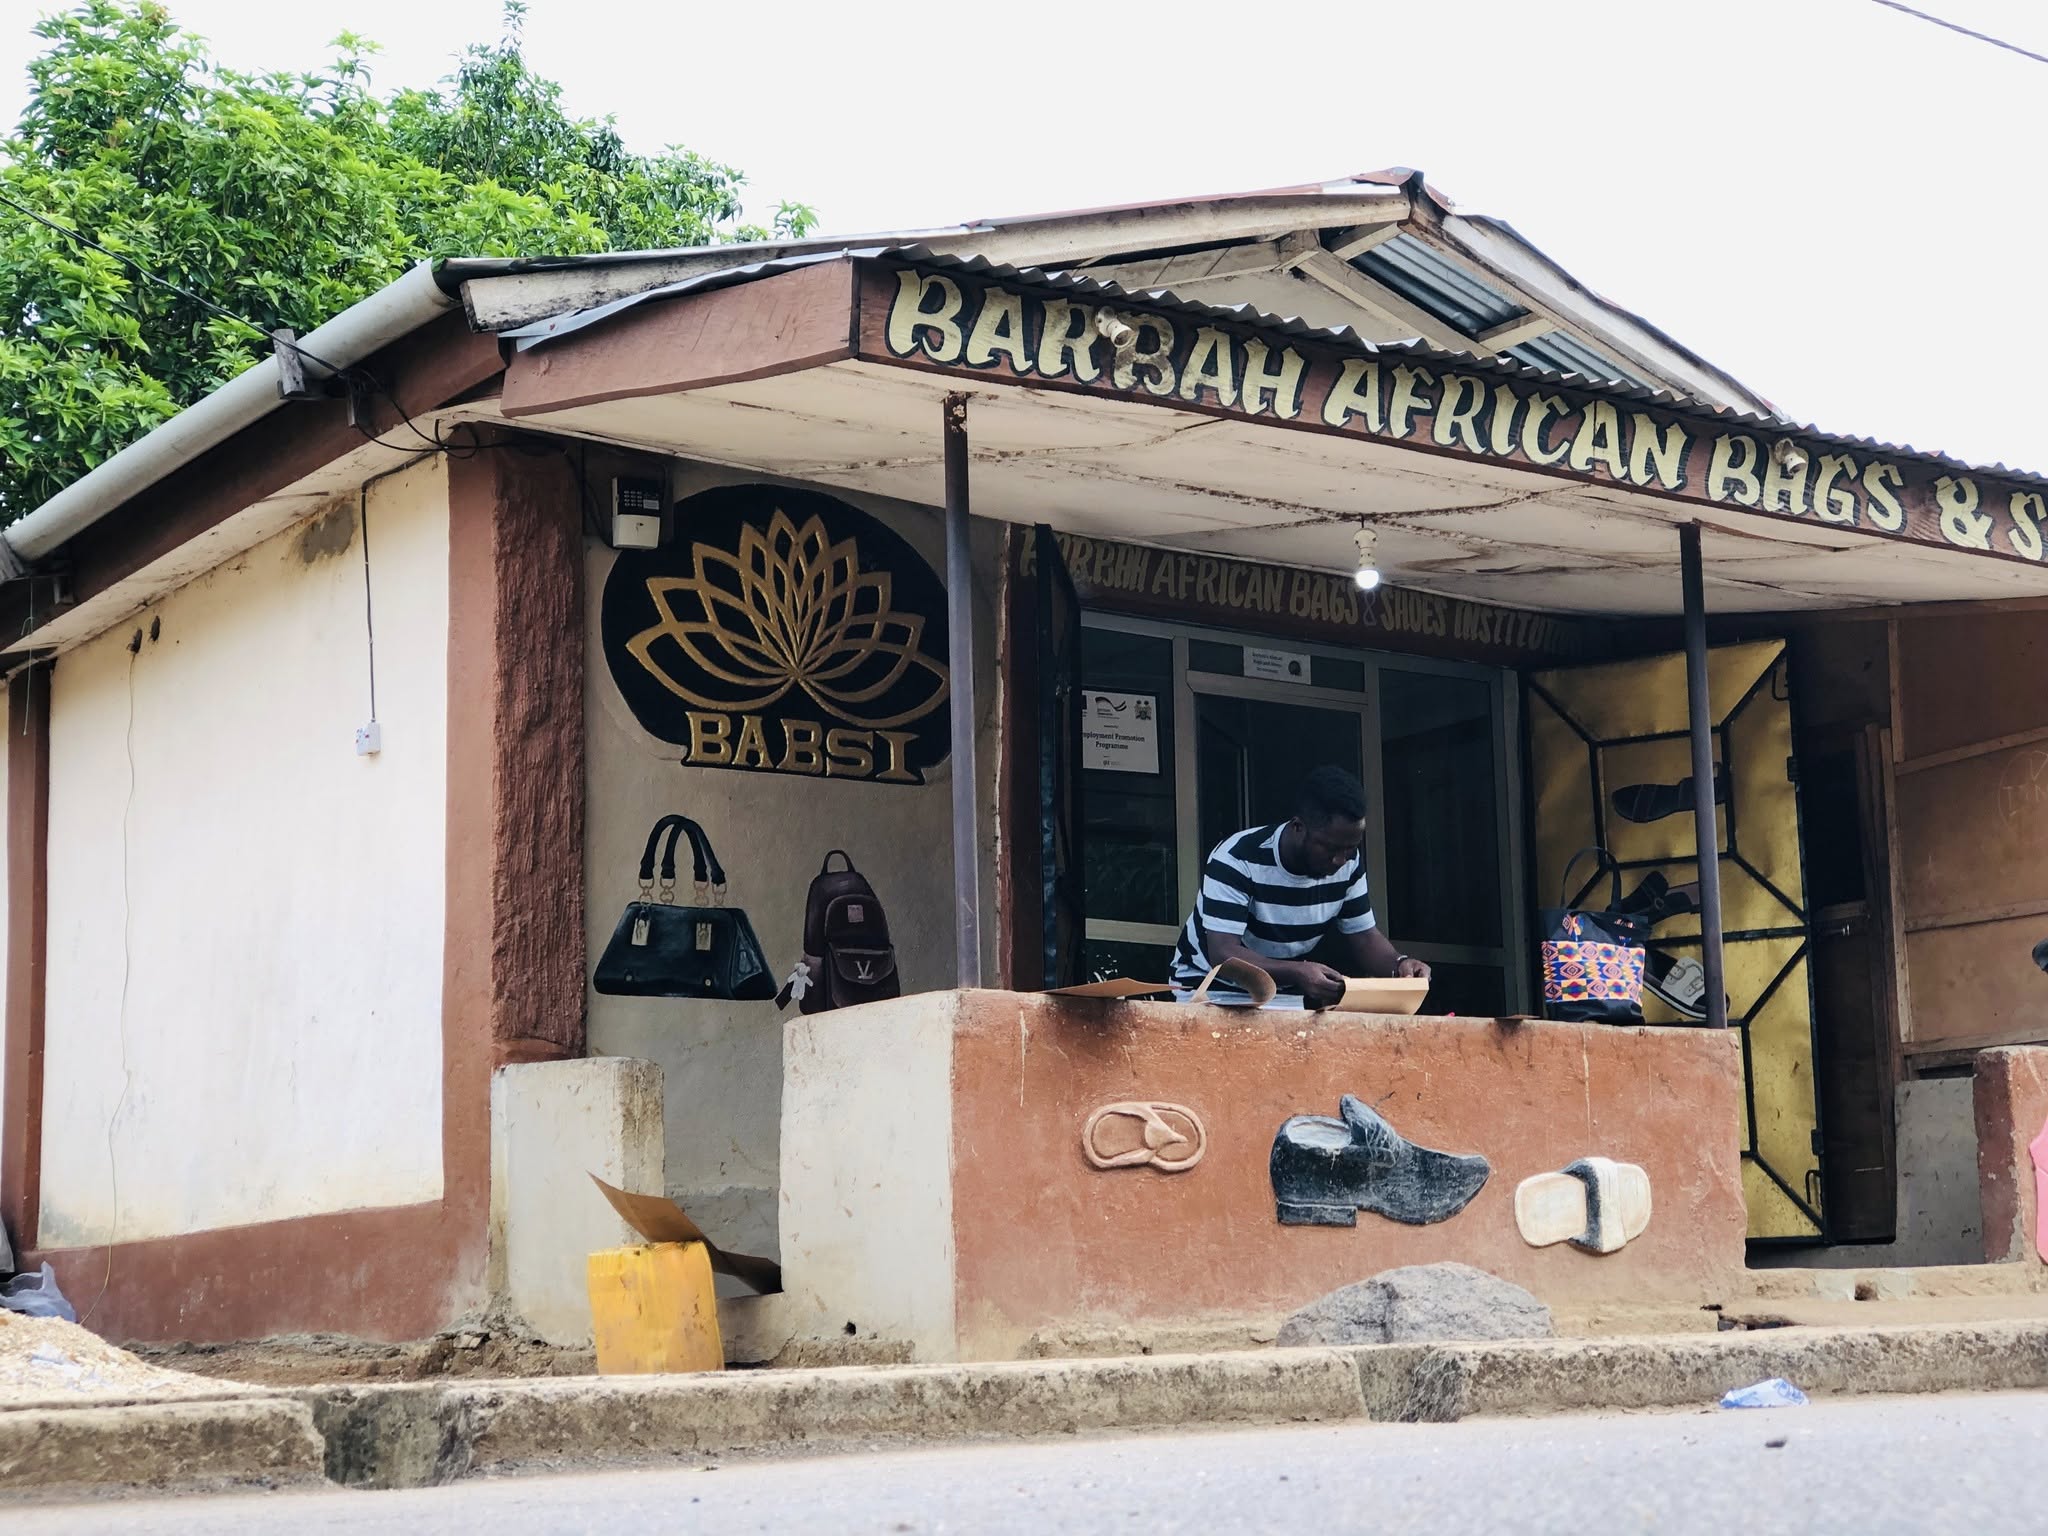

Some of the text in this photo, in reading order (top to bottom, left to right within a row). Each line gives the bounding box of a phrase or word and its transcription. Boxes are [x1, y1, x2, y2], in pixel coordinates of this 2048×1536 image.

[887, 269, 2048, 561] BARBAH AFRICAN BAGS & S
[1152, 552, 1285, 613] AFRICAN
[1289, 568, 1360, 625] BAGS
[1380, 585, 1448, 637] SHOES
[686, 711, 920, 781] BABSI
[1082, 731, 1146, 742] mployment Promotion
[1095, 741, 1129, 750] Programme
